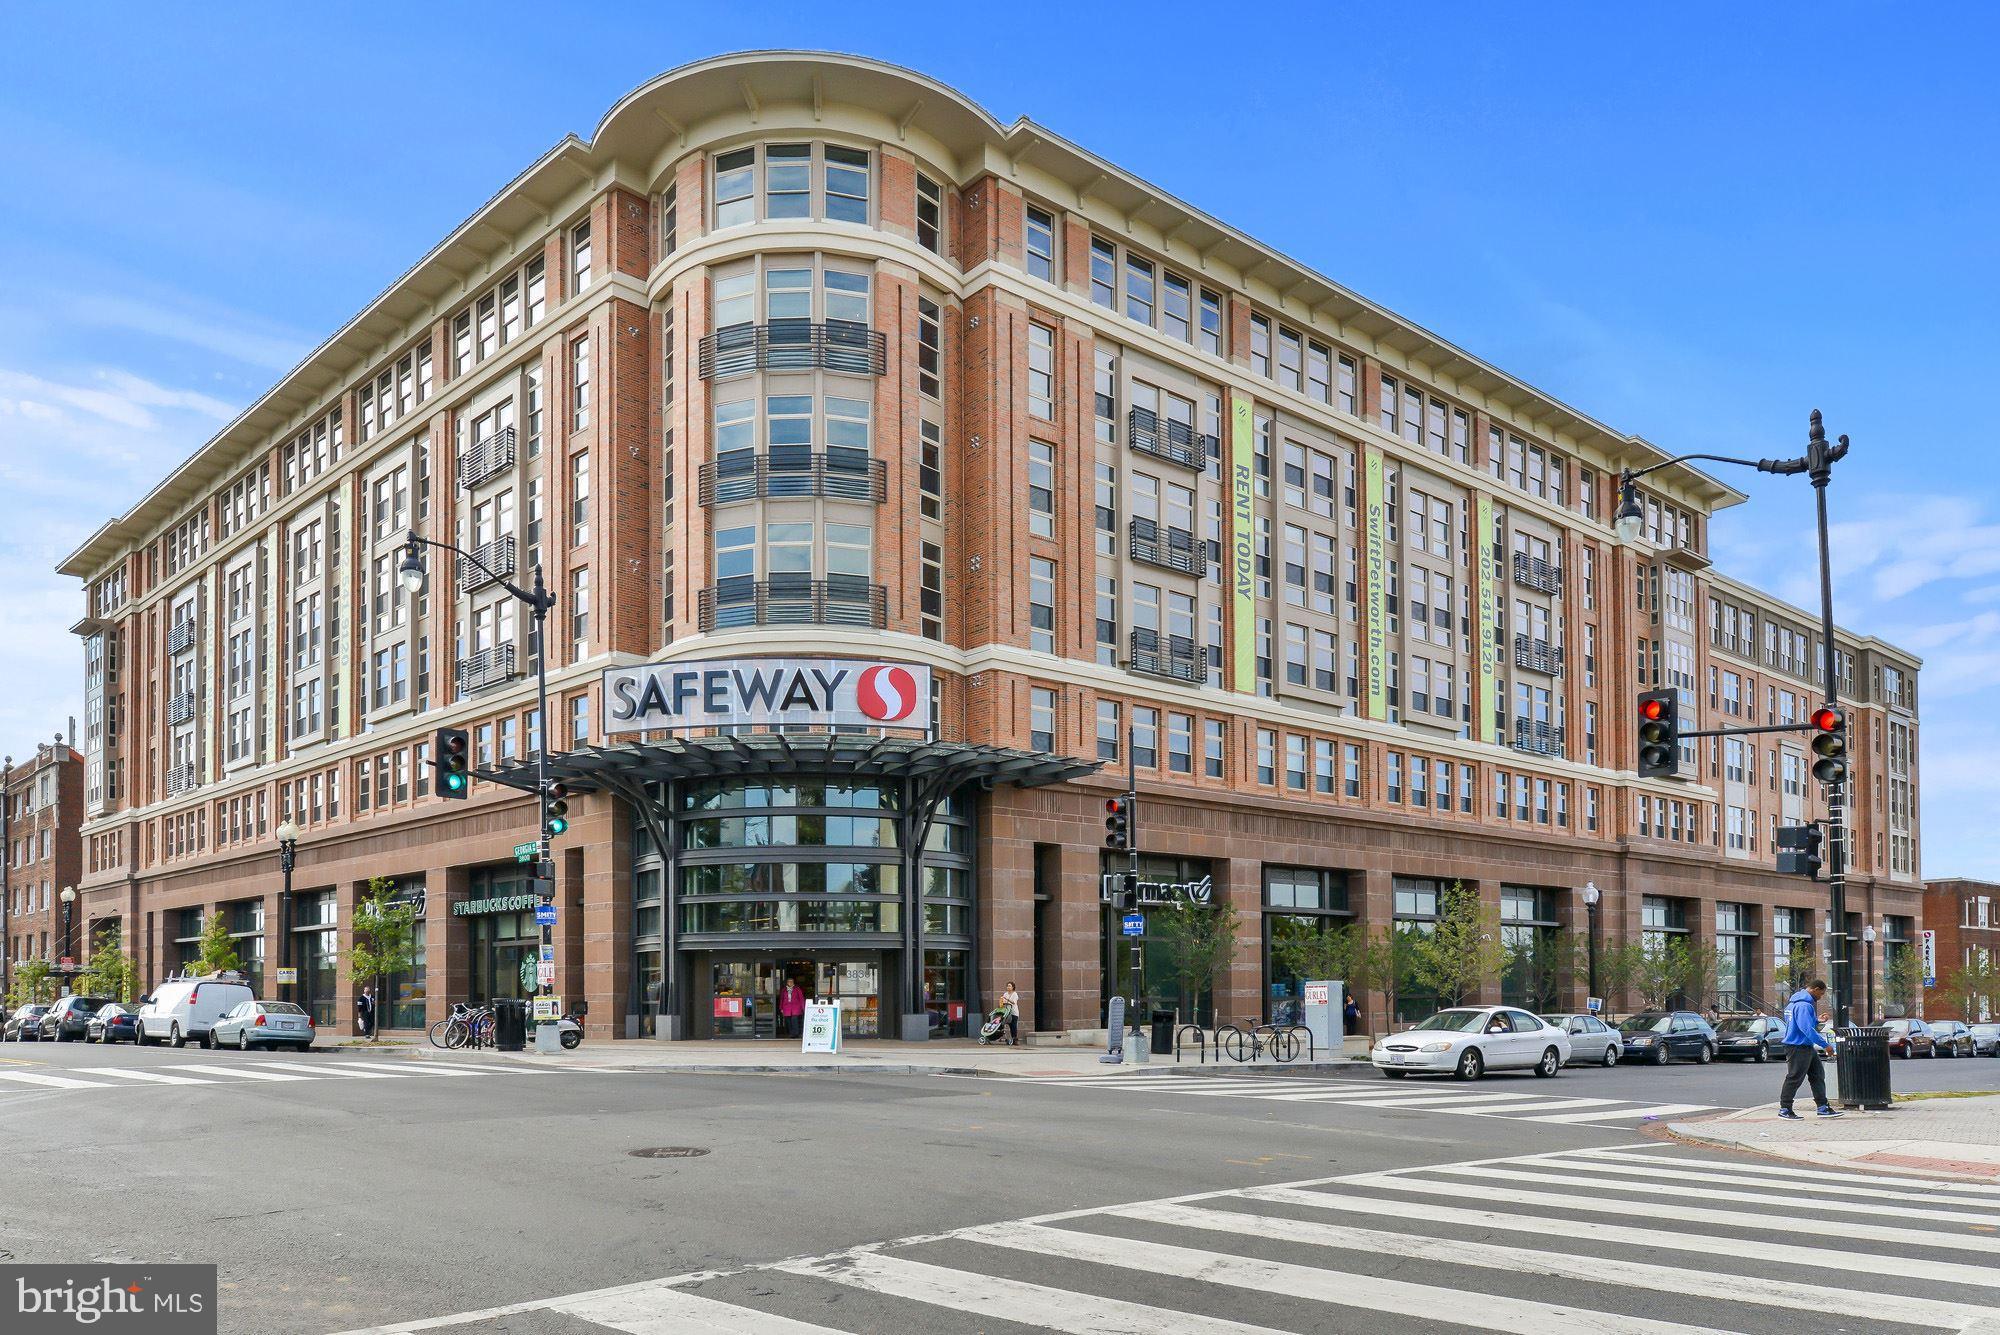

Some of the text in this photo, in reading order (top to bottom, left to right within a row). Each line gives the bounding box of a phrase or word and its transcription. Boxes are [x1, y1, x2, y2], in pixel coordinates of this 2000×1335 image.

[1236, 464, 1251, 601] RENT TODAY
[1369, 504, 1382, 696] SwiftPetworth.com
[1481, 545, 1492, 675] 202.541.9120
[612, 667, 851, 720] SAFEWAY
[453, 894, 541, 916] STARBUCKS COFFE
